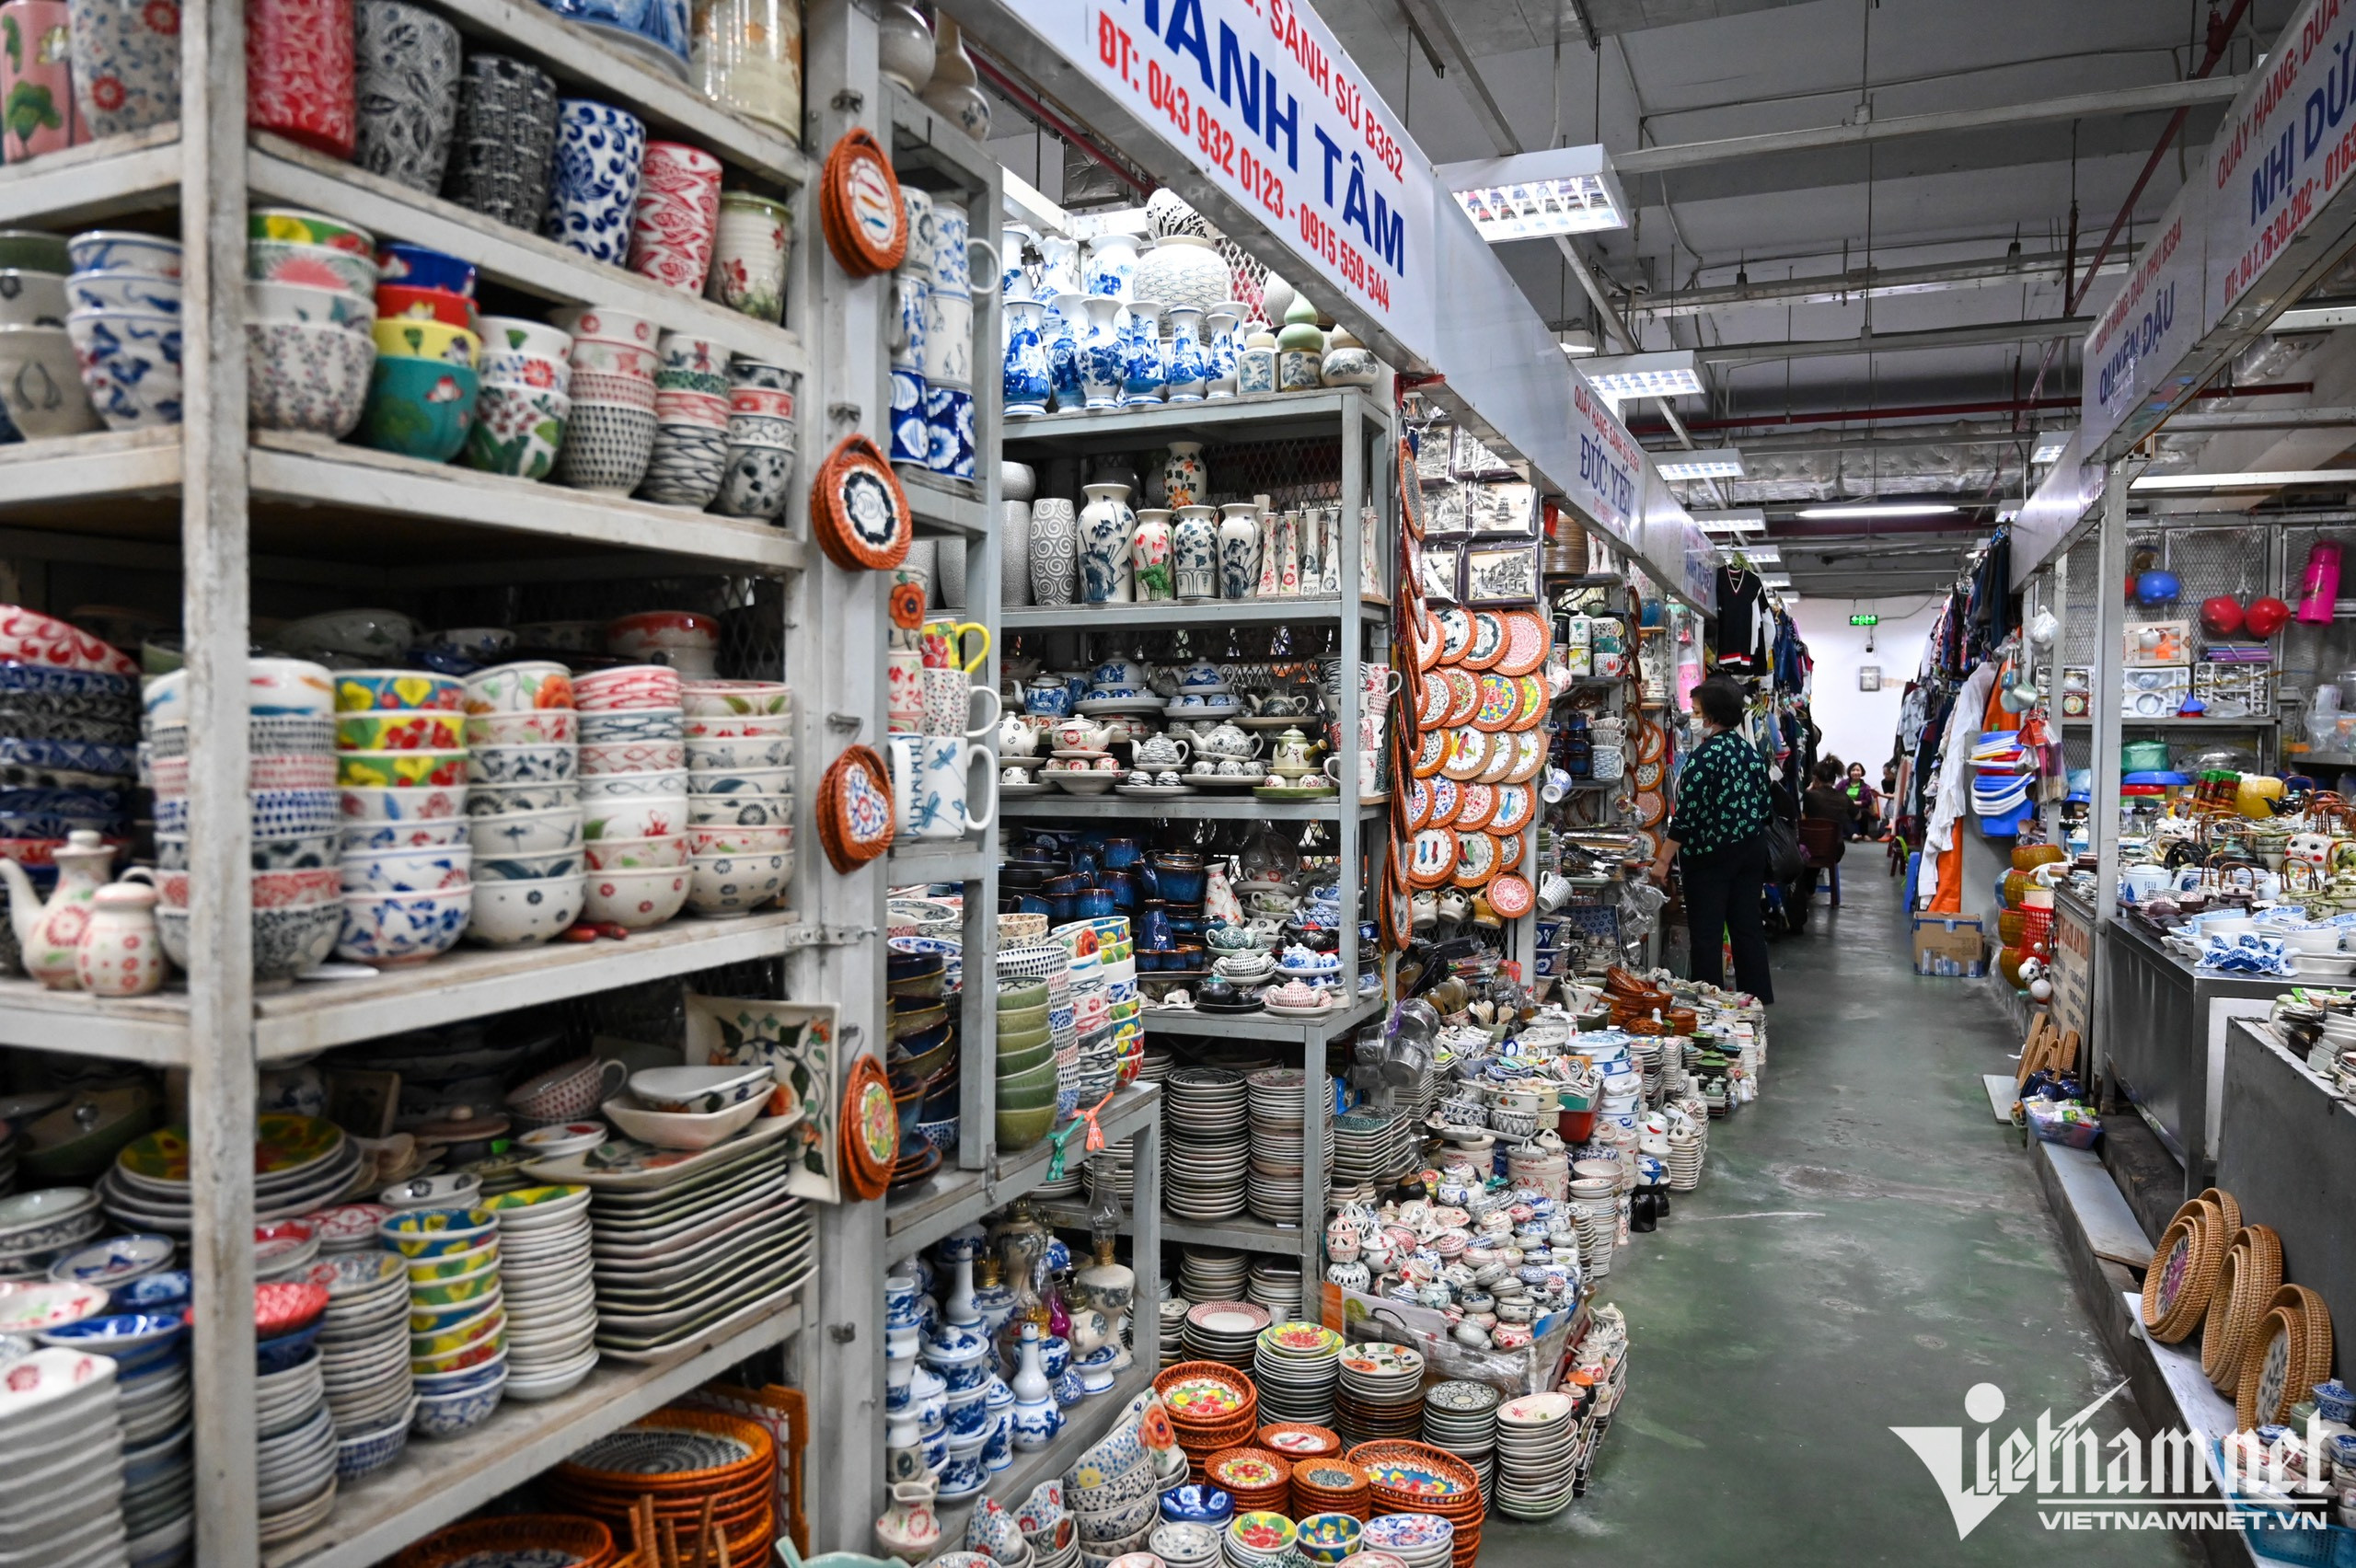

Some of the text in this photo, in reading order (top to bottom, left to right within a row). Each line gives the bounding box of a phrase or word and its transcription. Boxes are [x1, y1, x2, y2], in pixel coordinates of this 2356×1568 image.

[1099, 10, 1139, 93] ĐT:
[1149, 60, 1190, 136] 043
[1197, 106, 1234, 179] 932
[1241, 147, 1284, 220] 0123
[1300, 202, 1336, 266] 0915
[1340, 238, 1364, 291] 559
[1368, 264, 1390, 313] 544
[1315, 123, 1403, 278] TÂM
[1335, 73, 1361, 131] SỨ
[1366, 108, 1403, 183] B362
[2251, 30, 2356, 227] NHỊ DỪ
[1579, 432, 1608, 497] ĐỨC
[1611, 462, 1635, 518] YẾN
